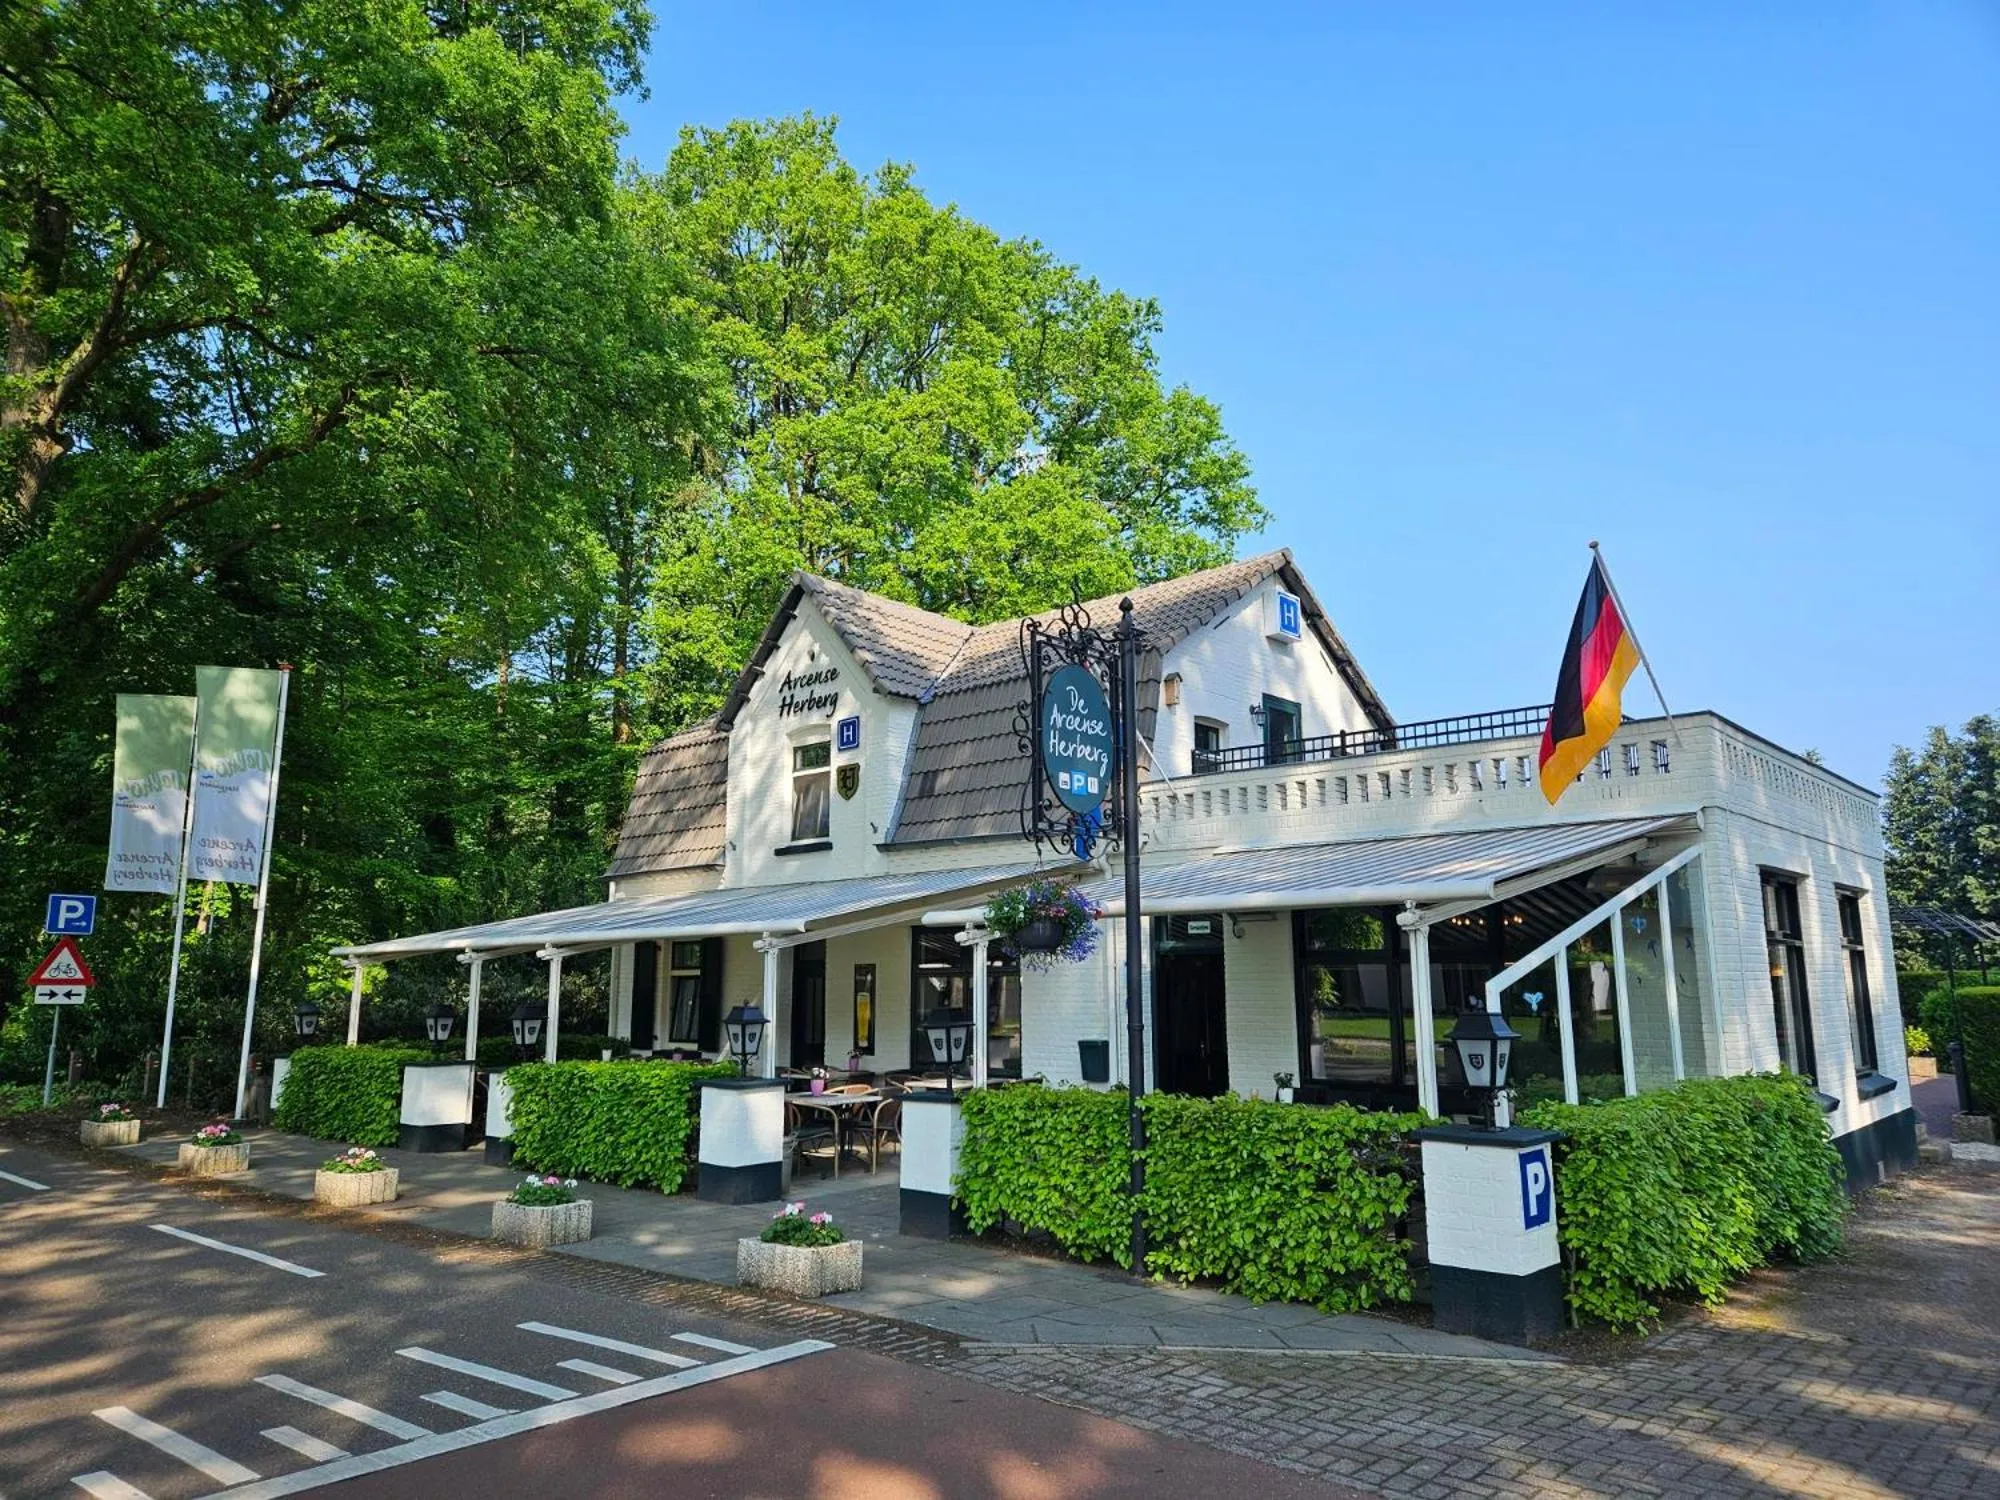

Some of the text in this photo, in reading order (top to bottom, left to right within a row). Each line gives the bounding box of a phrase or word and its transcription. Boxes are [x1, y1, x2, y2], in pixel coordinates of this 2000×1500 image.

[1283, 602, 1295, 628] H
[778, 666, 840, 694] Arcense
[778, 691, 839, 720] Herberg
[1066, 685, 1089, 714] De
[843, 725, 853, 743] H
[1049, 704, 1107, 737] Arcense
[1049, 731, 1108, 778] Herberg
[1074, 775, 1084, 791] P
[57, 899, 85, 929] P
[1526, 1161, 1546, 1217] P
